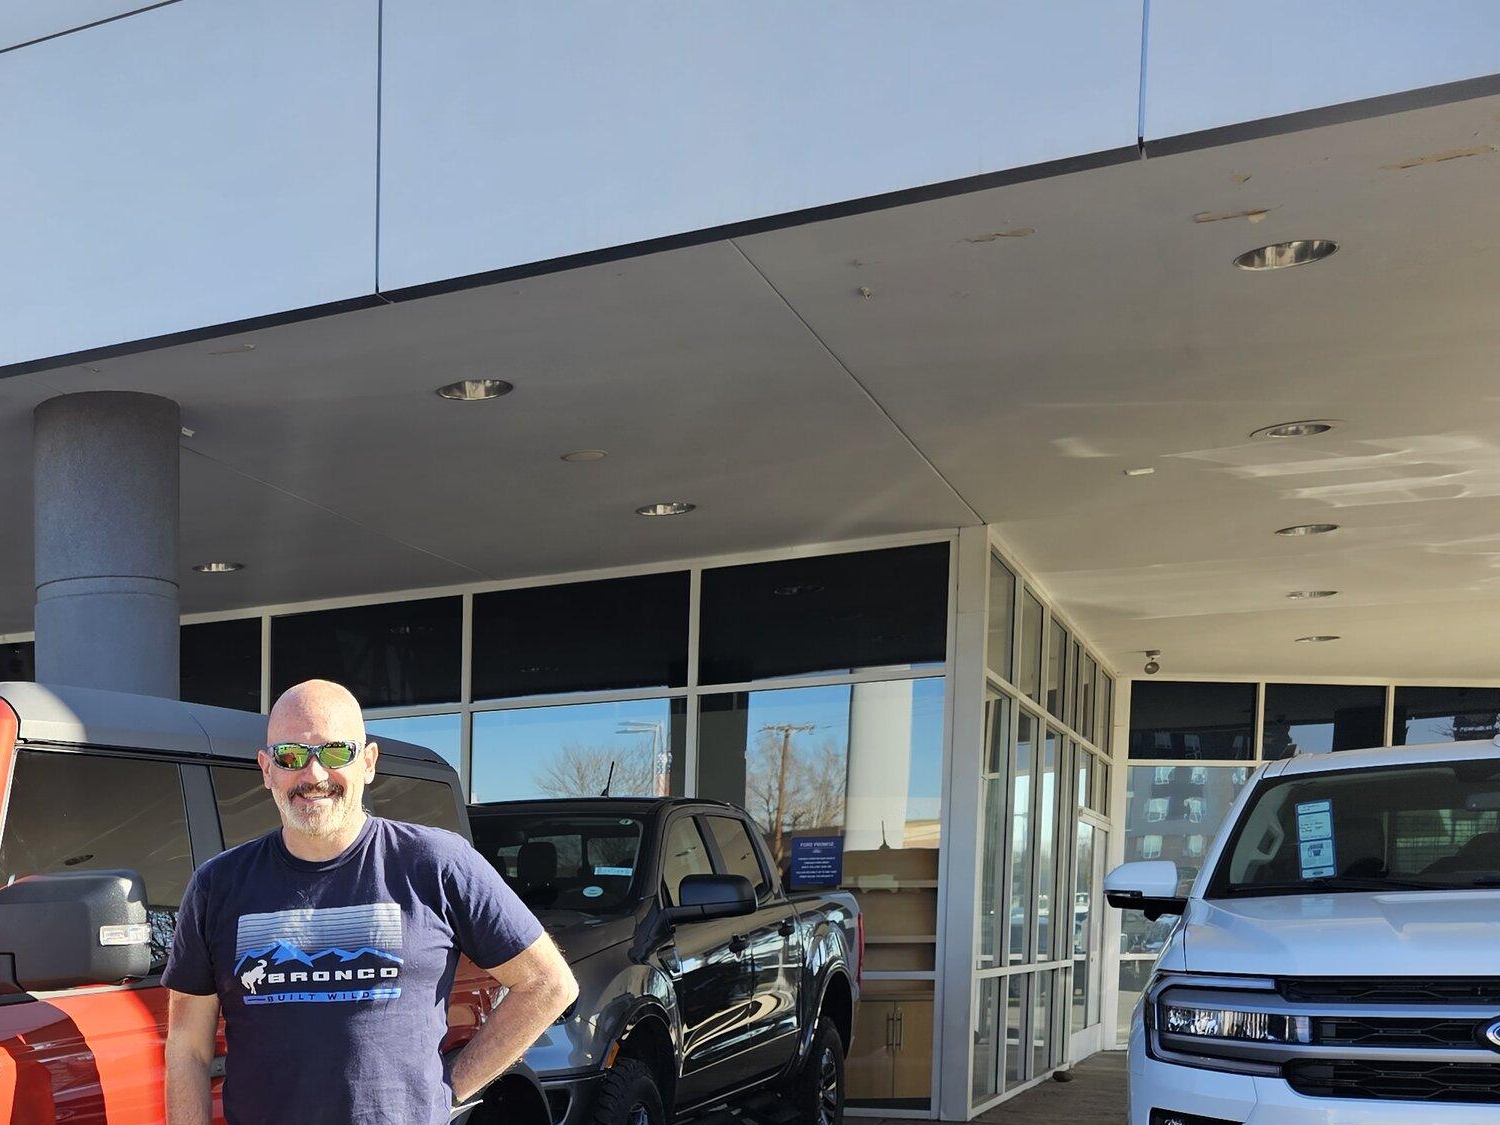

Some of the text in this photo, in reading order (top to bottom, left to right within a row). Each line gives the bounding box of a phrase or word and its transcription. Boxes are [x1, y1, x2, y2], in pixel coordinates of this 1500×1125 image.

[267, 967, 399, 984] BRONCO
[266, 991, 371, 1002] BUILT WILD
